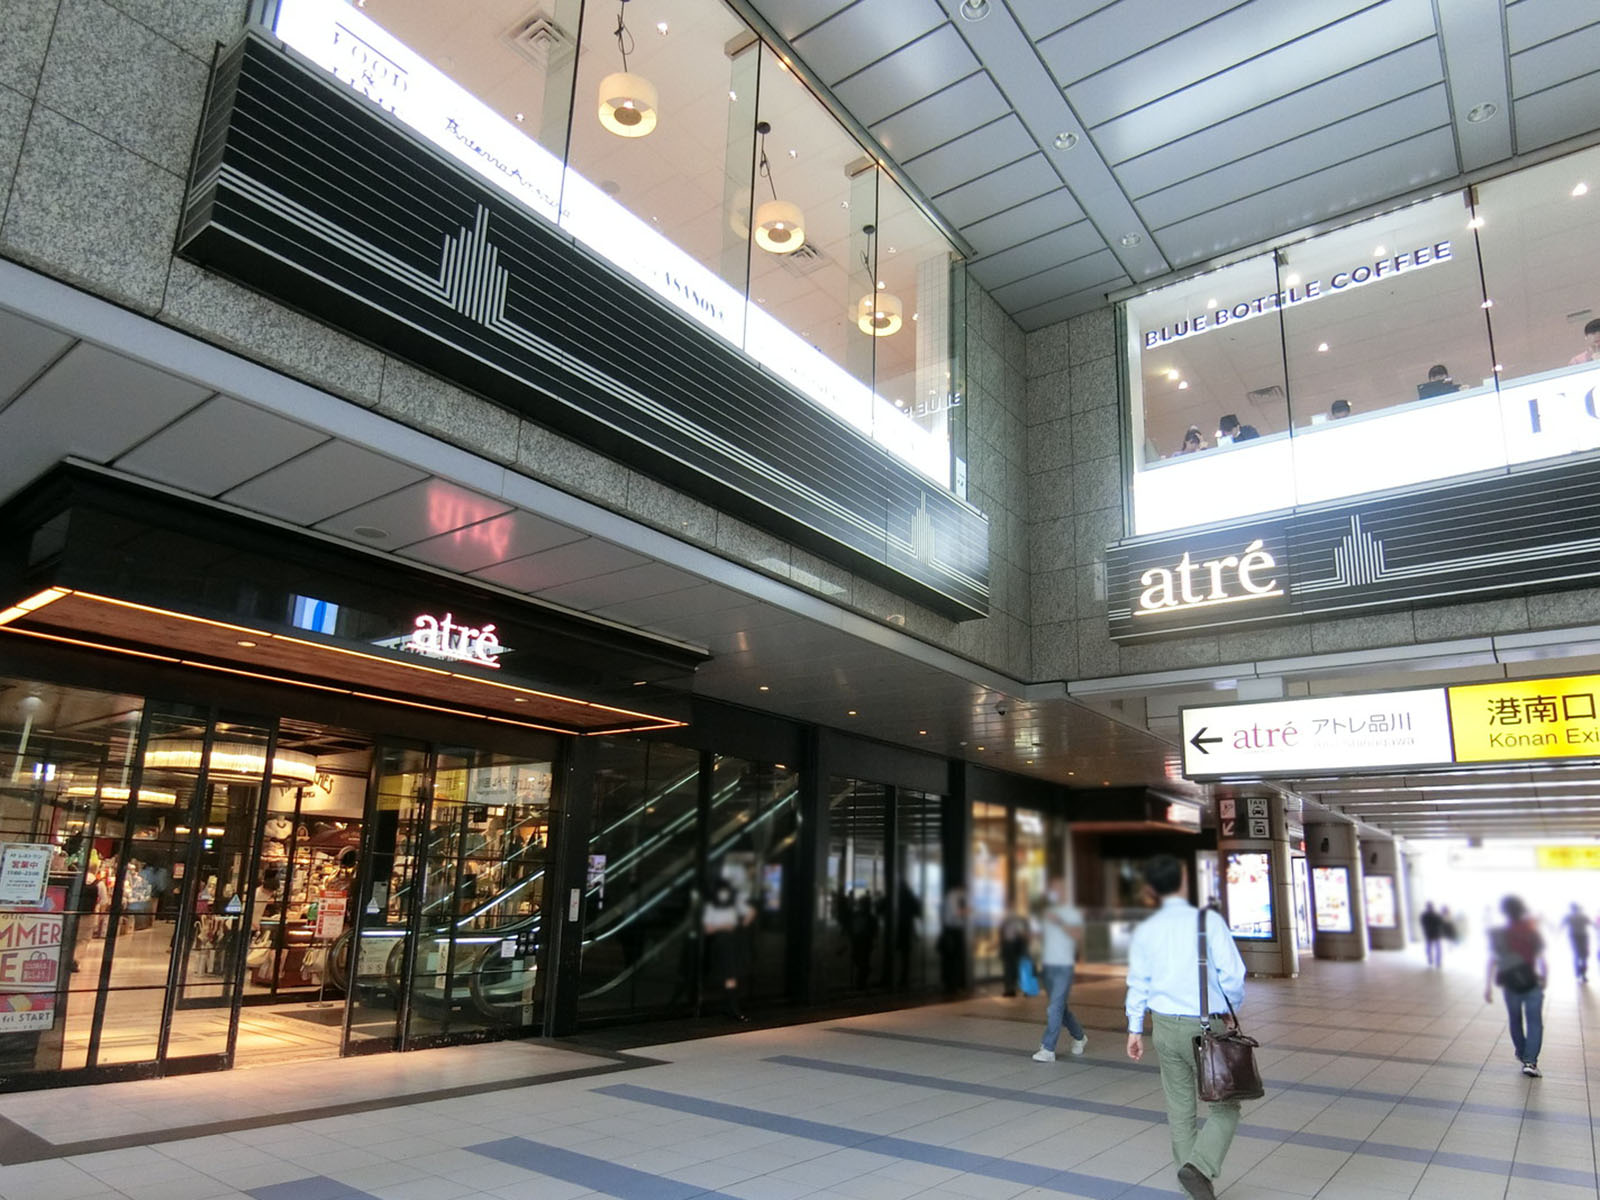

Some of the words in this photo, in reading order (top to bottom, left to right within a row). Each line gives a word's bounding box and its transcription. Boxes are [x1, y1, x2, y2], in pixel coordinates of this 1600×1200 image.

[1145, 315, 1206, 347] BLUE
[1214, 280, 1321, 326] BOTTLE
[1330, 240, 1452, 290] COFFEE
[1138, 539, 1278, 611] atré
[411, 611, 501, 664] atré
[1312, 711, 1413, 735] アトレ品川
[1487, 693, 1597, 725] 港南口
[1233, 720, 1298, 749] atré
[1489, 732, 1558, 748] Kōnan
[18, 1012, 51, 1023] START
